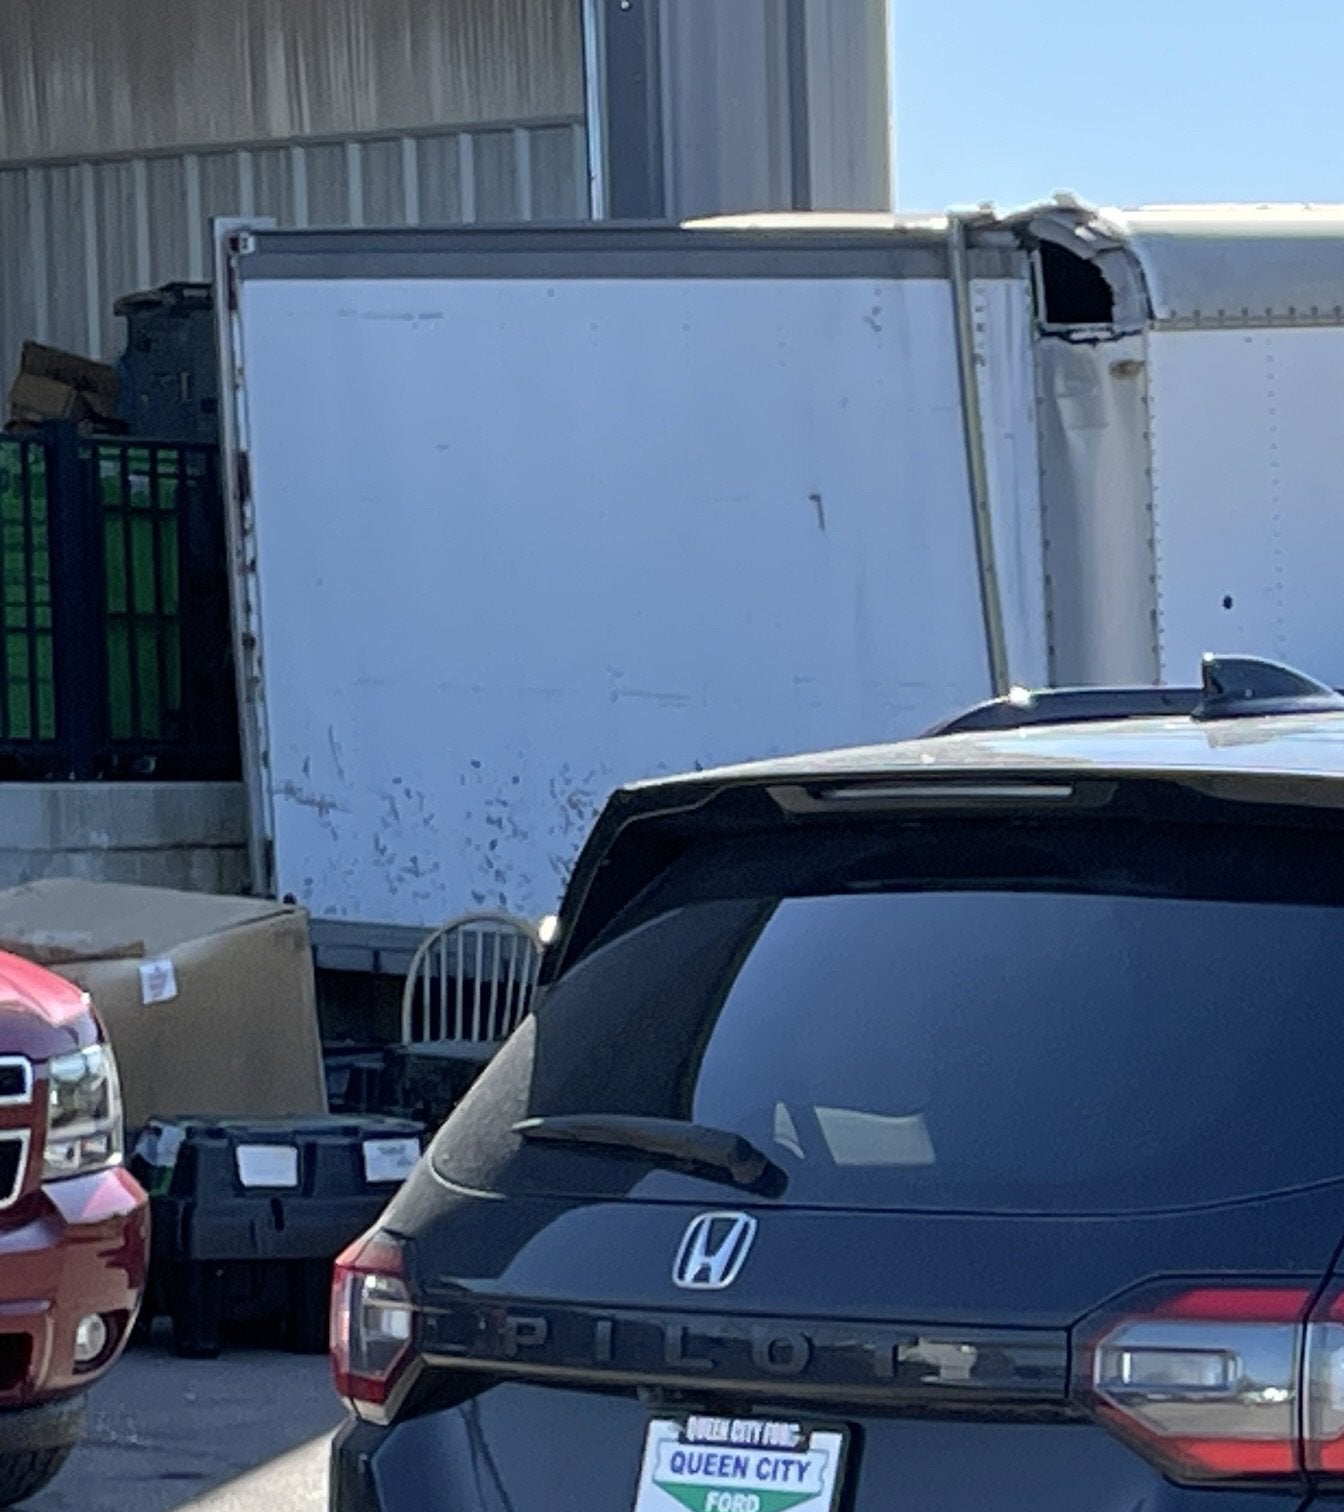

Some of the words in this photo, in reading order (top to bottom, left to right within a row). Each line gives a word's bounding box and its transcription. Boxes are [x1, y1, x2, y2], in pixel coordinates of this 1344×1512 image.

[730, 1419, 764, 1446] CITY
[669, 1450, 748, 1479] QUEEN
[755, 1456, 811, 1483] CITY
